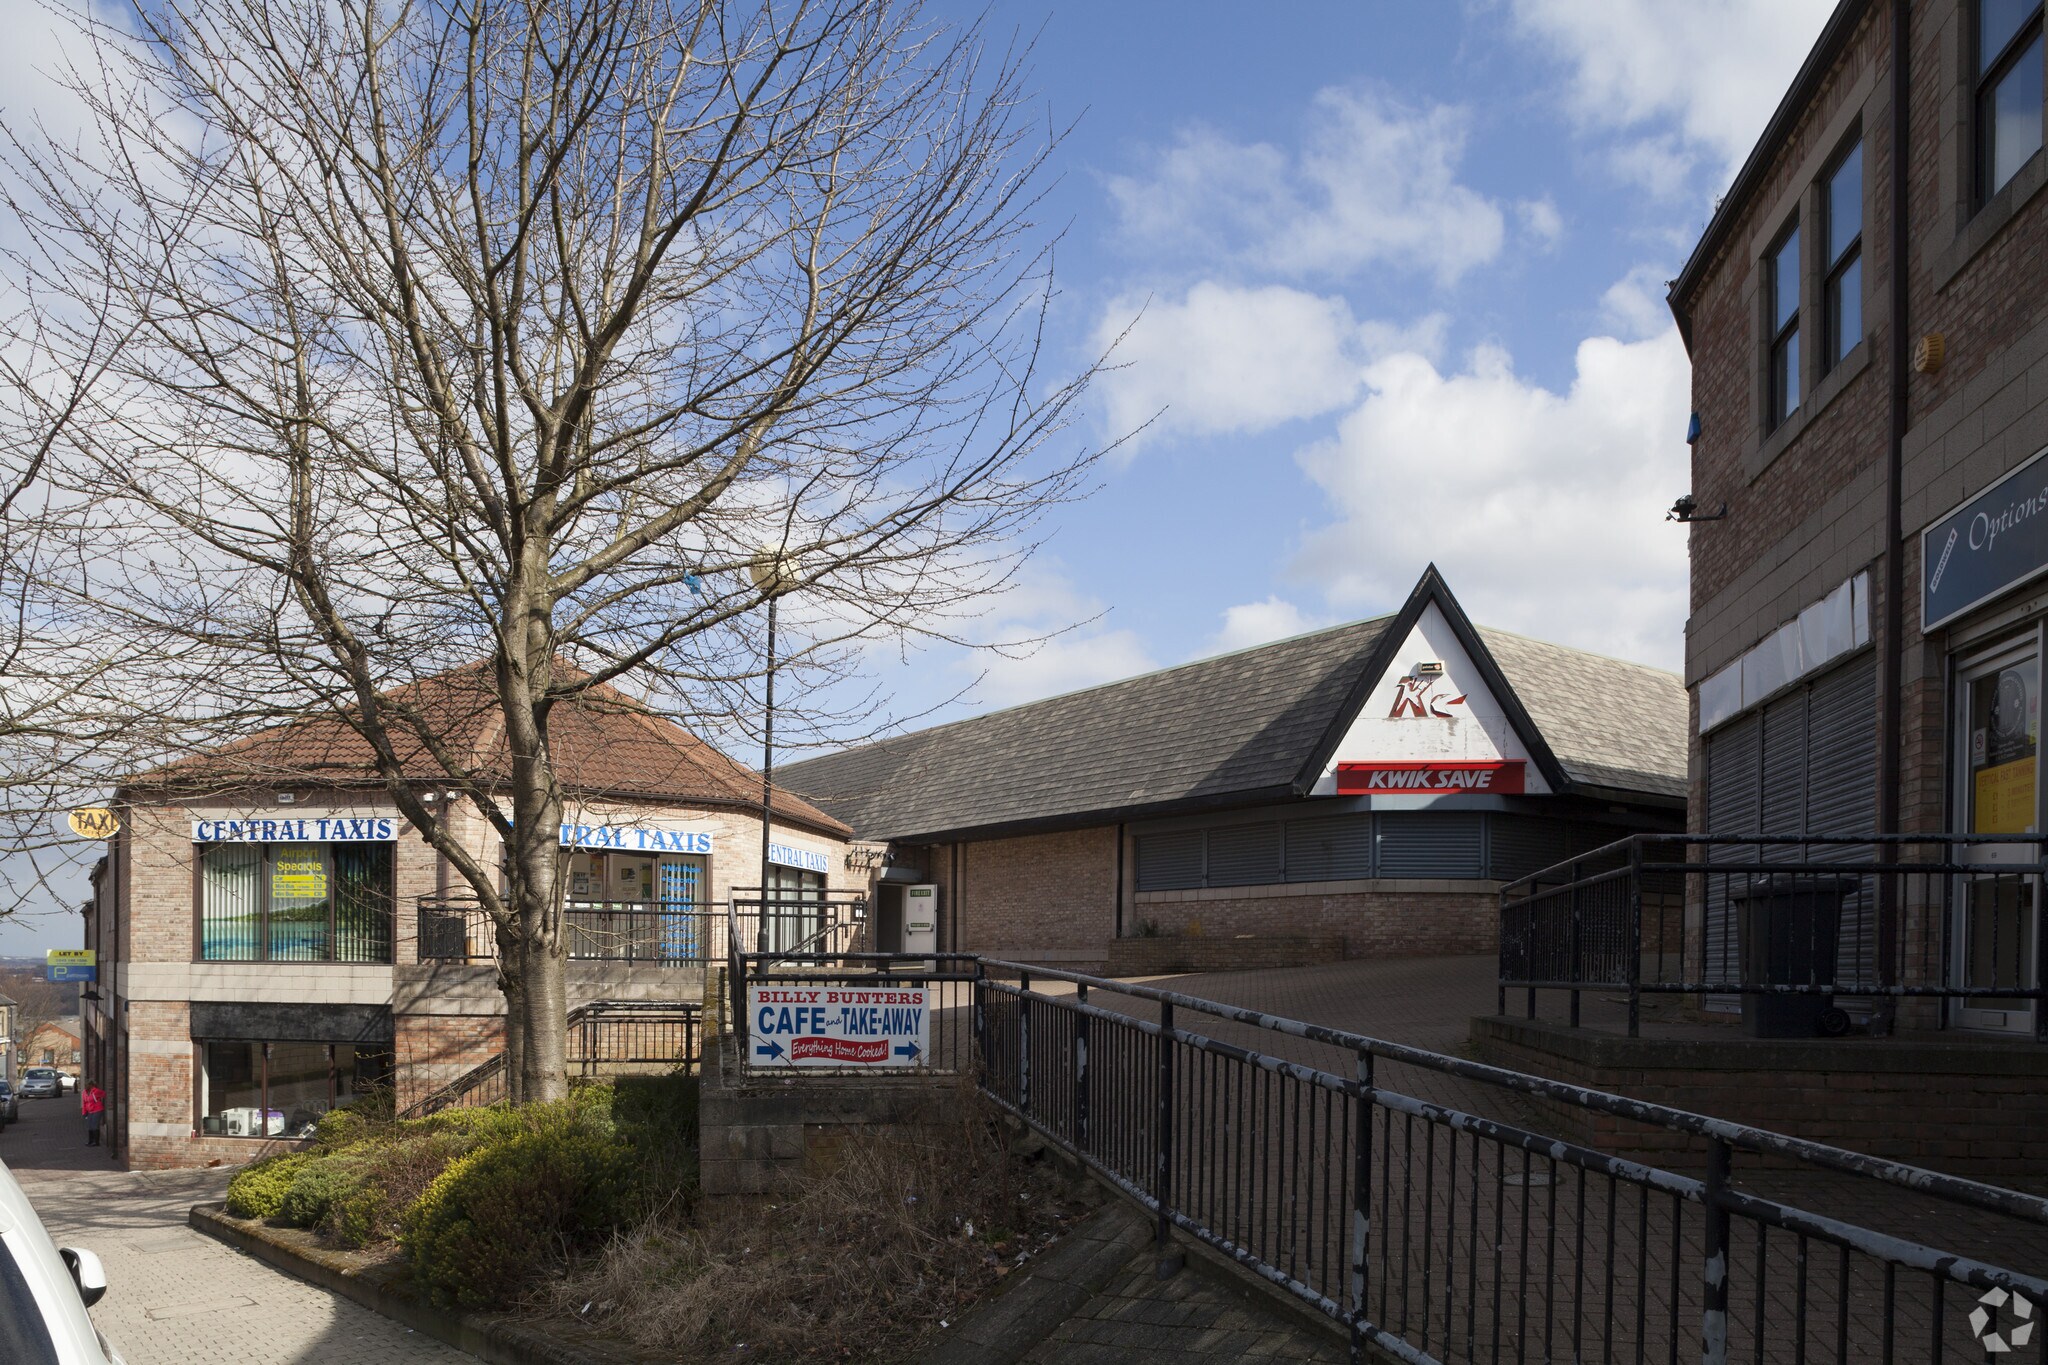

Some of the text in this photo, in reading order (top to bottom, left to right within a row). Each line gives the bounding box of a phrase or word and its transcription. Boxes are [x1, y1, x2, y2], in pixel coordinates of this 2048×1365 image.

[1969, 486, 2048, 552] Options
[1931, 538, 1955, 588] GOLDWELL
[1368, 770, 1494, 788] KWIK SAVE
[74, 812, 116, 831] TAXI
[197, 818, 391, 841] CENTRAL TAXIS
[634, 829, 711, 853] TAXIS
[281, 848, 319, 859] Airport
[768, 844, 828, 872] ENTRAL TAXIS
[758, 991, 923, 1005] BILLY BUNTERS
[758, 1006, 922, 1035] CAFE and TAKE-AWAY
[792, 1040, 887, 1058] Everything Home Cooked!
